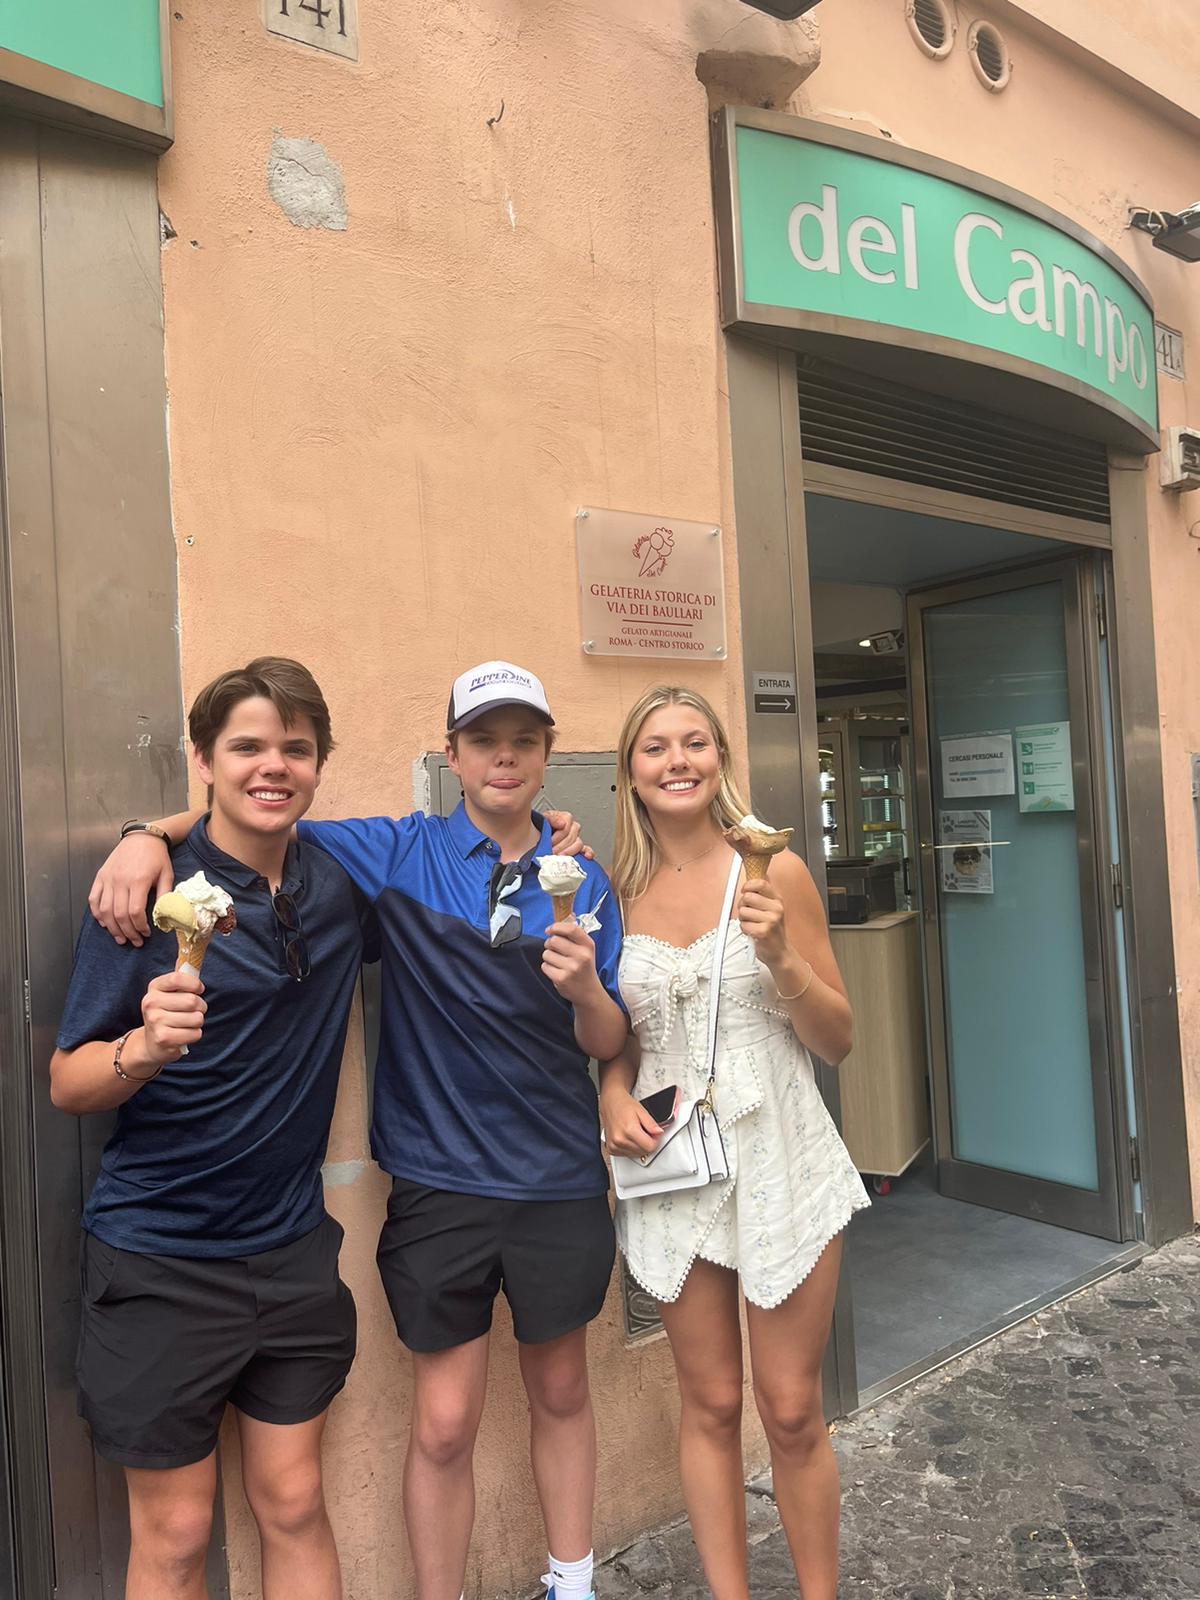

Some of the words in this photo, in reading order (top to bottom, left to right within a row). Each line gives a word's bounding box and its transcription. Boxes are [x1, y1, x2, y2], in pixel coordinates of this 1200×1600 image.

[787, 183, 919, 290] del
[953, 211, 1148, 390] Campo
[590, 584, 652, 600] GELATERIA
[654, 590, 701, 605] STORICA
[704, 594, 716, 606] DI
[606, 601, 627, 614] VIA
[630, 603, 649, 616] DEI
[653, 605, 703, 620] BAULLARI
[621, 627, 649, 635] GELATO
[649, 629, 693, 638] ARTIGIANALE
[609, 637, 633, 647] ROMA
[638, 639, 671, 648] CENTRO
[671, 640, 705, 650] STORICO
[758, 678, 791, 688] ENTRATA
[948, 754, 971, 762] CERCASI
[971, 752, 1004, 761] PERSONALE
